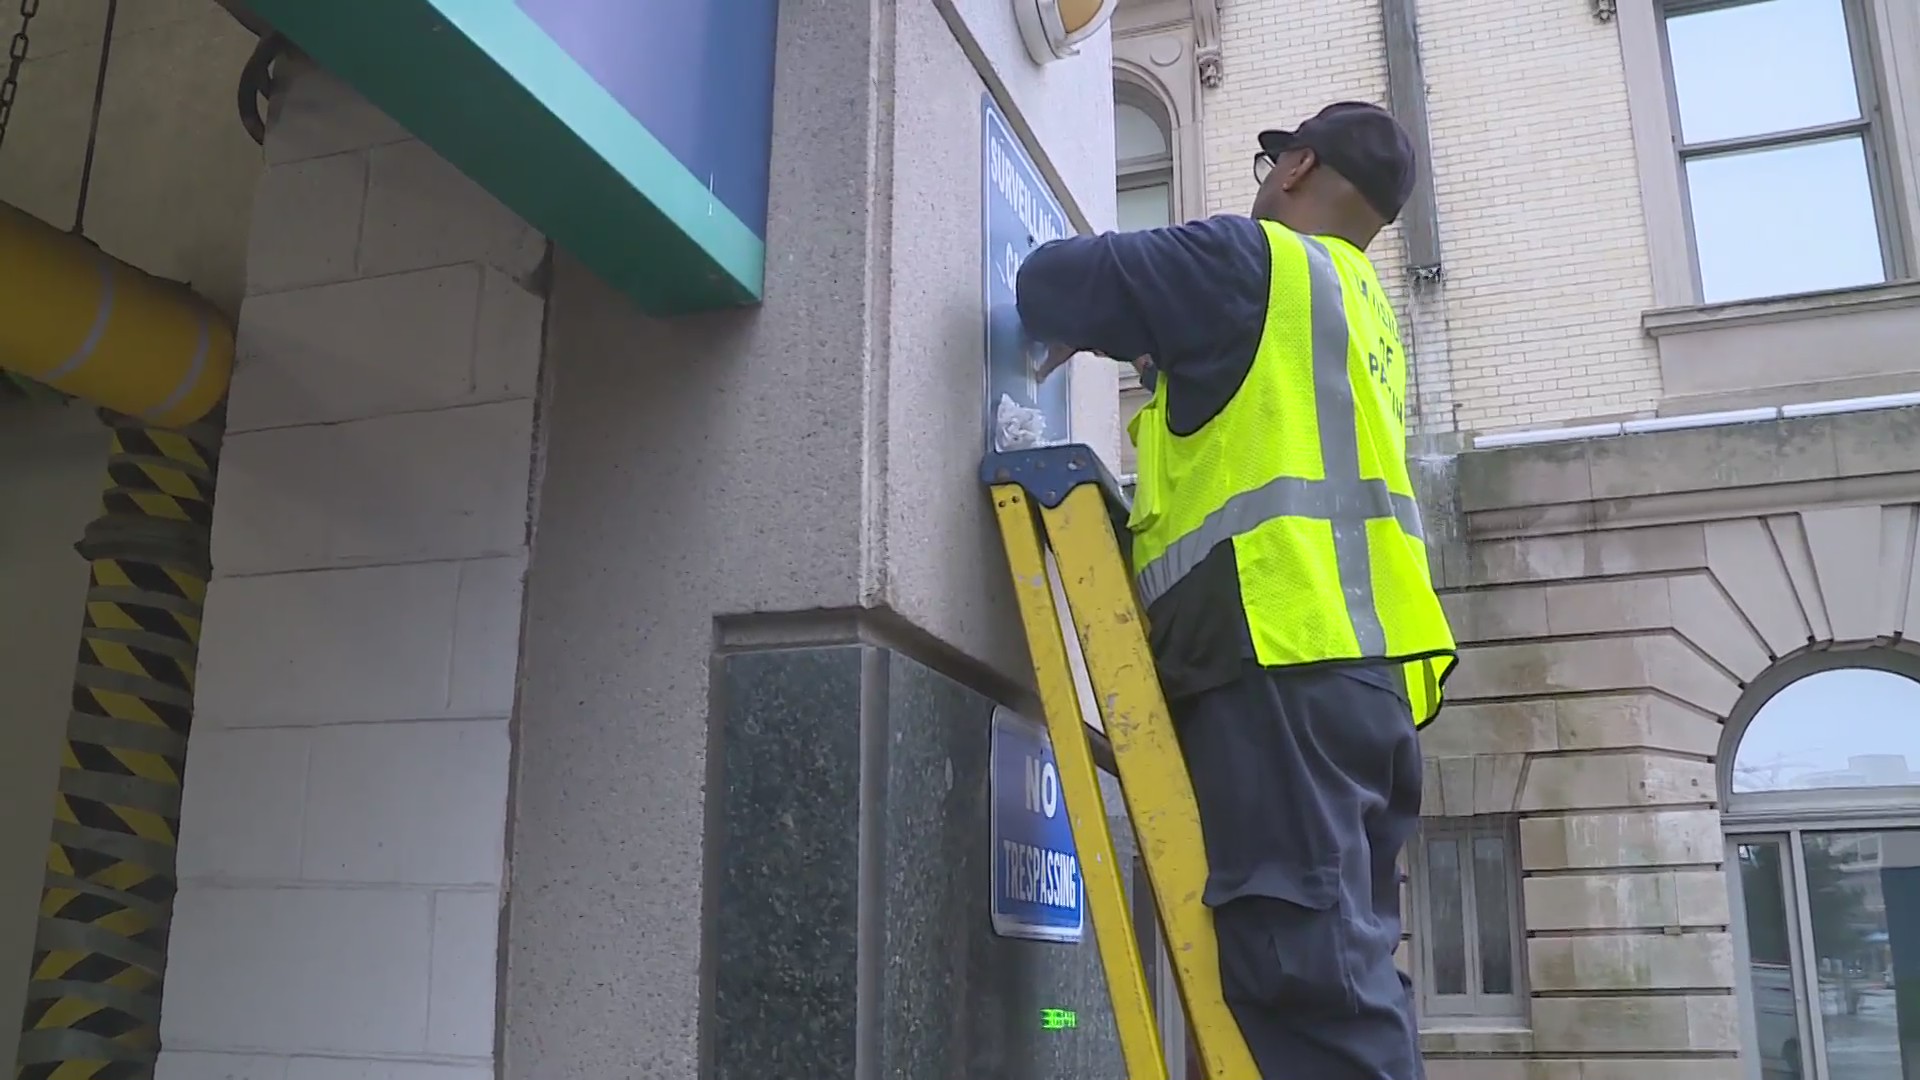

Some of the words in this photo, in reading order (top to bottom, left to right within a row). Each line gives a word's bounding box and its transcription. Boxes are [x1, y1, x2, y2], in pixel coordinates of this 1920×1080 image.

[990, 136, 1062, 247] SURVEILLAN
[1025, 755, 1058, 818] NO
[1003, 839, 1077, 909] TRESPASSING
